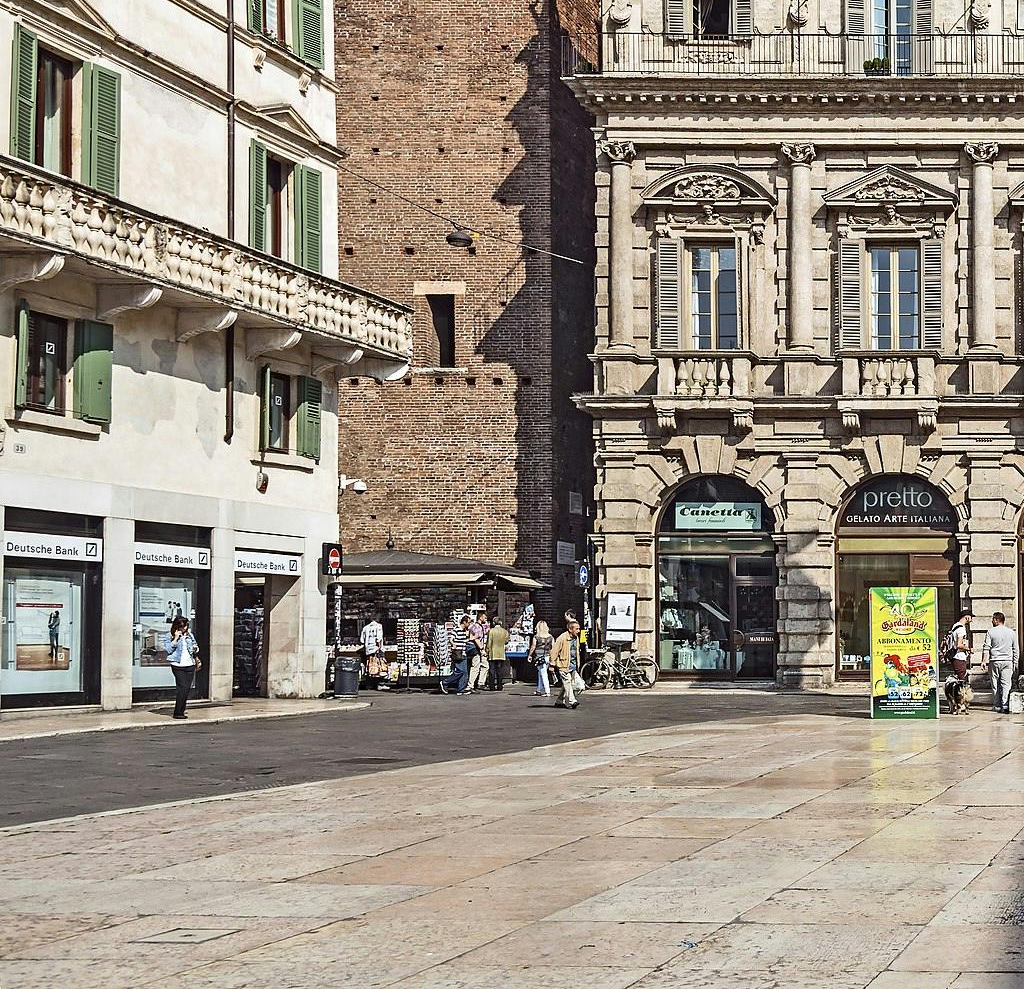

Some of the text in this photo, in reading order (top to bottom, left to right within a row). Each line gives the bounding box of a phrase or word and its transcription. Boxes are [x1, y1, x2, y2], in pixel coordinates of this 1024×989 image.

[864, 486, 932, 511] pretto
[680, 508, 742, 516] Canetta
[846, 514, 950, 523] GELATO ARTE ITALIANA
[6, 542, 79, 557] Deutsche Bank
[136, 551, 194, 564] Deutsche Bank
[237, 559, 286, 572] Deutsche Bank
[882, 617, 925, 630] Gardaland
